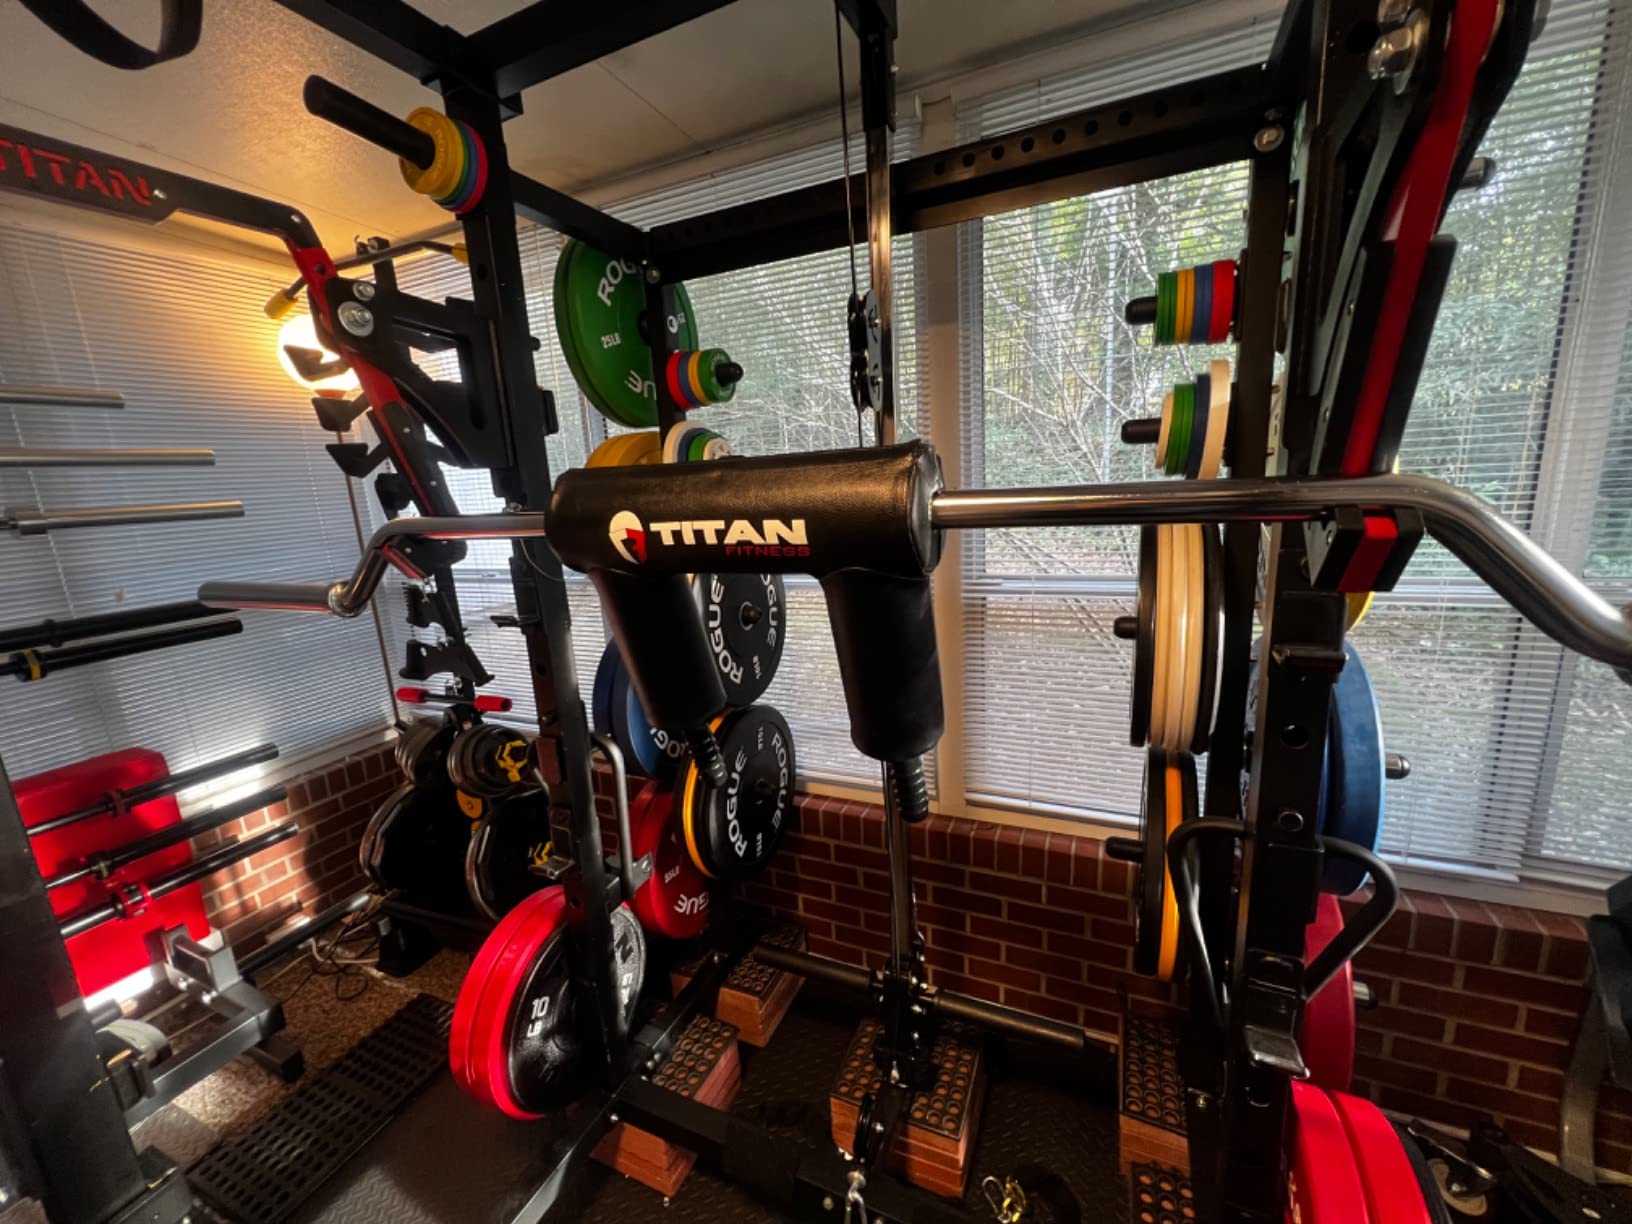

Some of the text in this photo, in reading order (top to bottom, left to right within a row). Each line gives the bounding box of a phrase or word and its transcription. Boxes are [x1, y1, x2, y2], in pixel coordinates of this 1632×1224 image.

[601, 333, 622, 349] 25LB
[650, 519, 808, 545] TITAN
[725, 546, 811, 557] FITNESS
[709, 579, 744, 684] ROGUE
[771, 731, 788, 830] ROGUE
[727, 747, 748, 858] ROGUE
[531, 996, 550, 1020] 10
[526, 1020, 543, 1037] LB
